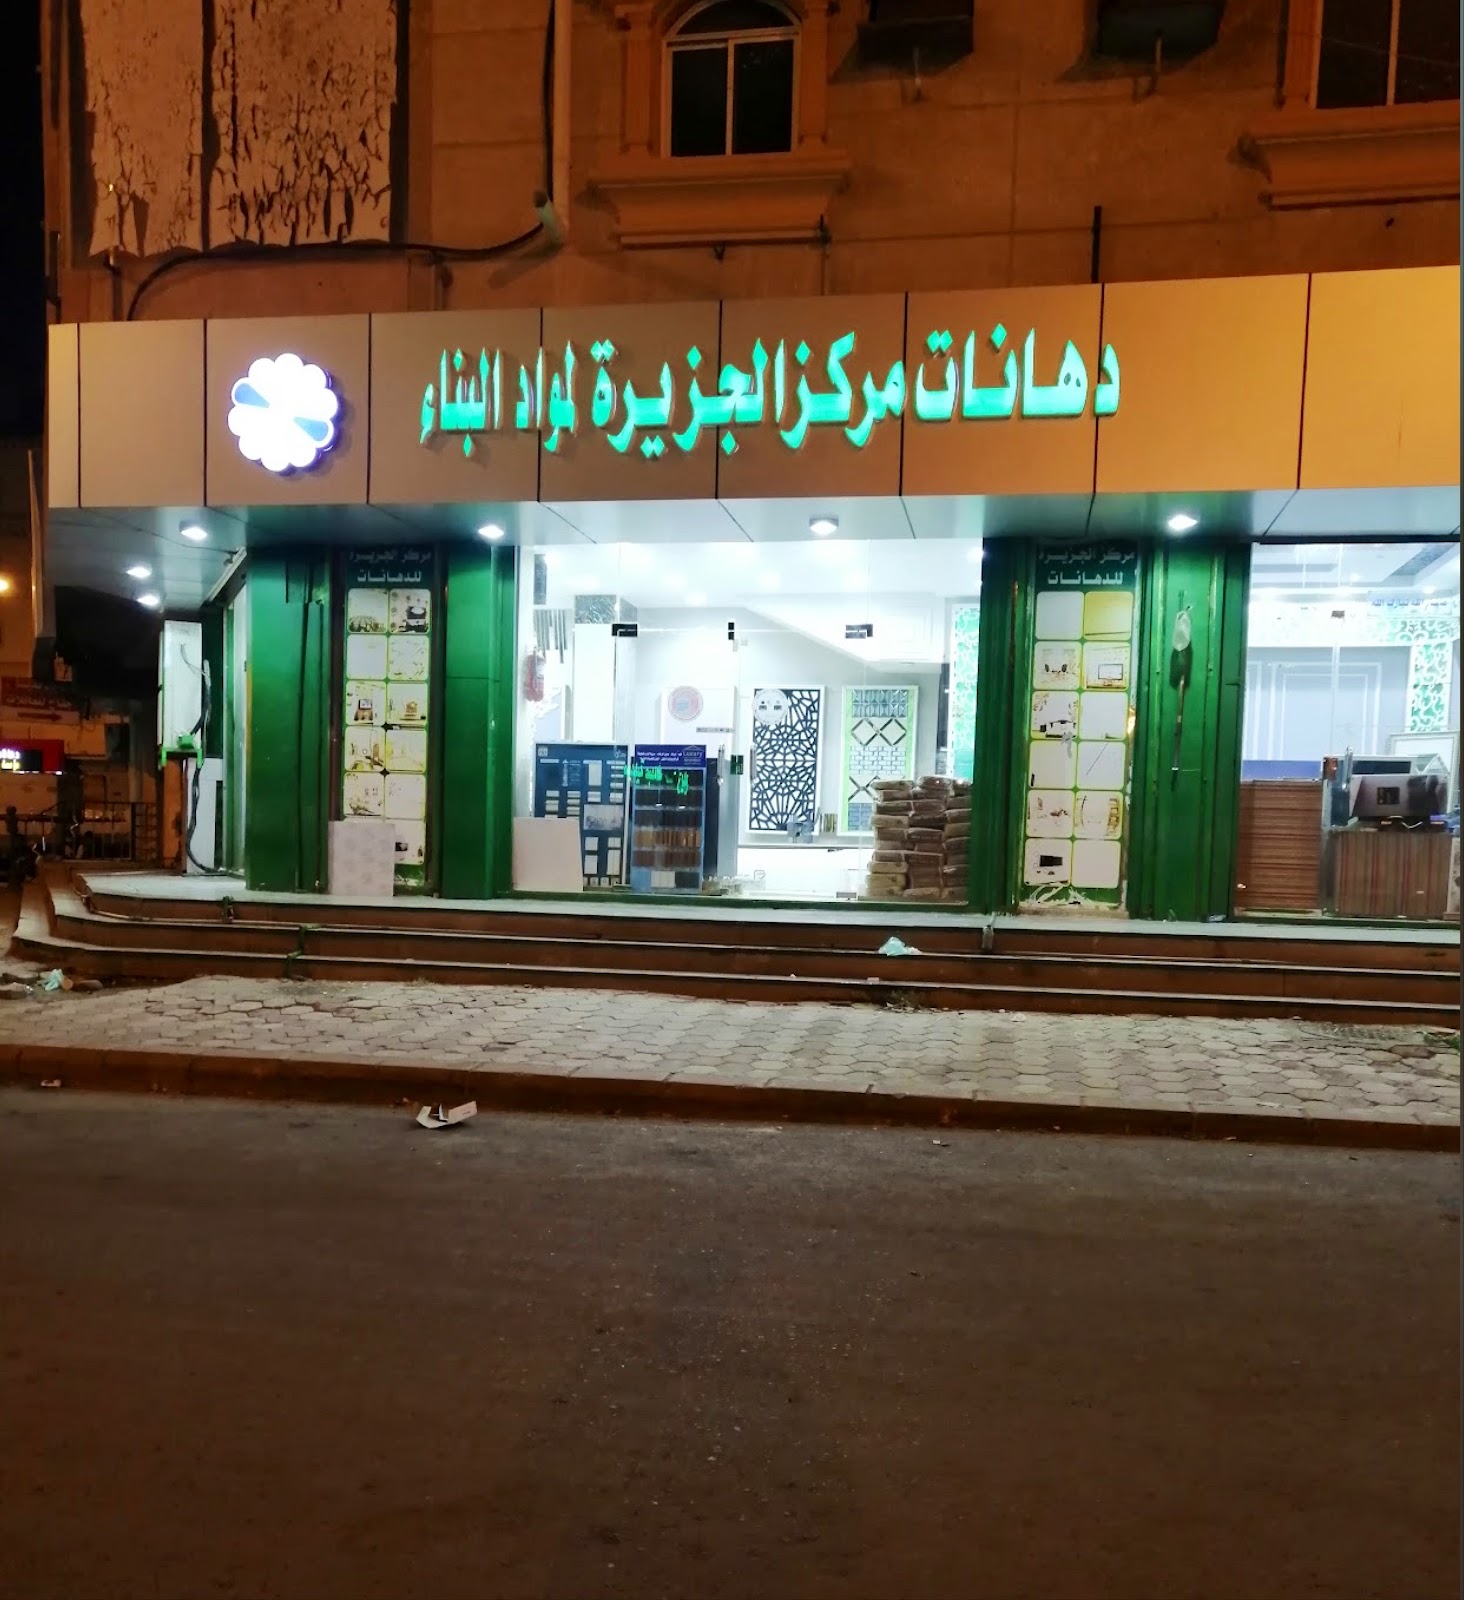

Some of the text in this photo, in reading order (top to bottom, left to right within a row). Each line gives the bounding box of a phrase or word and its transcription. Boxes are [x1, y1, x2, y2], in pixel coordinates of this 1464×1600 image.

[419, 323, 1121, 459] دهانات مركز الجزيرة لمواد البناء
[357, 569, 422, 583] للدهانات
[1047, 570, 1124, 586] للدهانات
